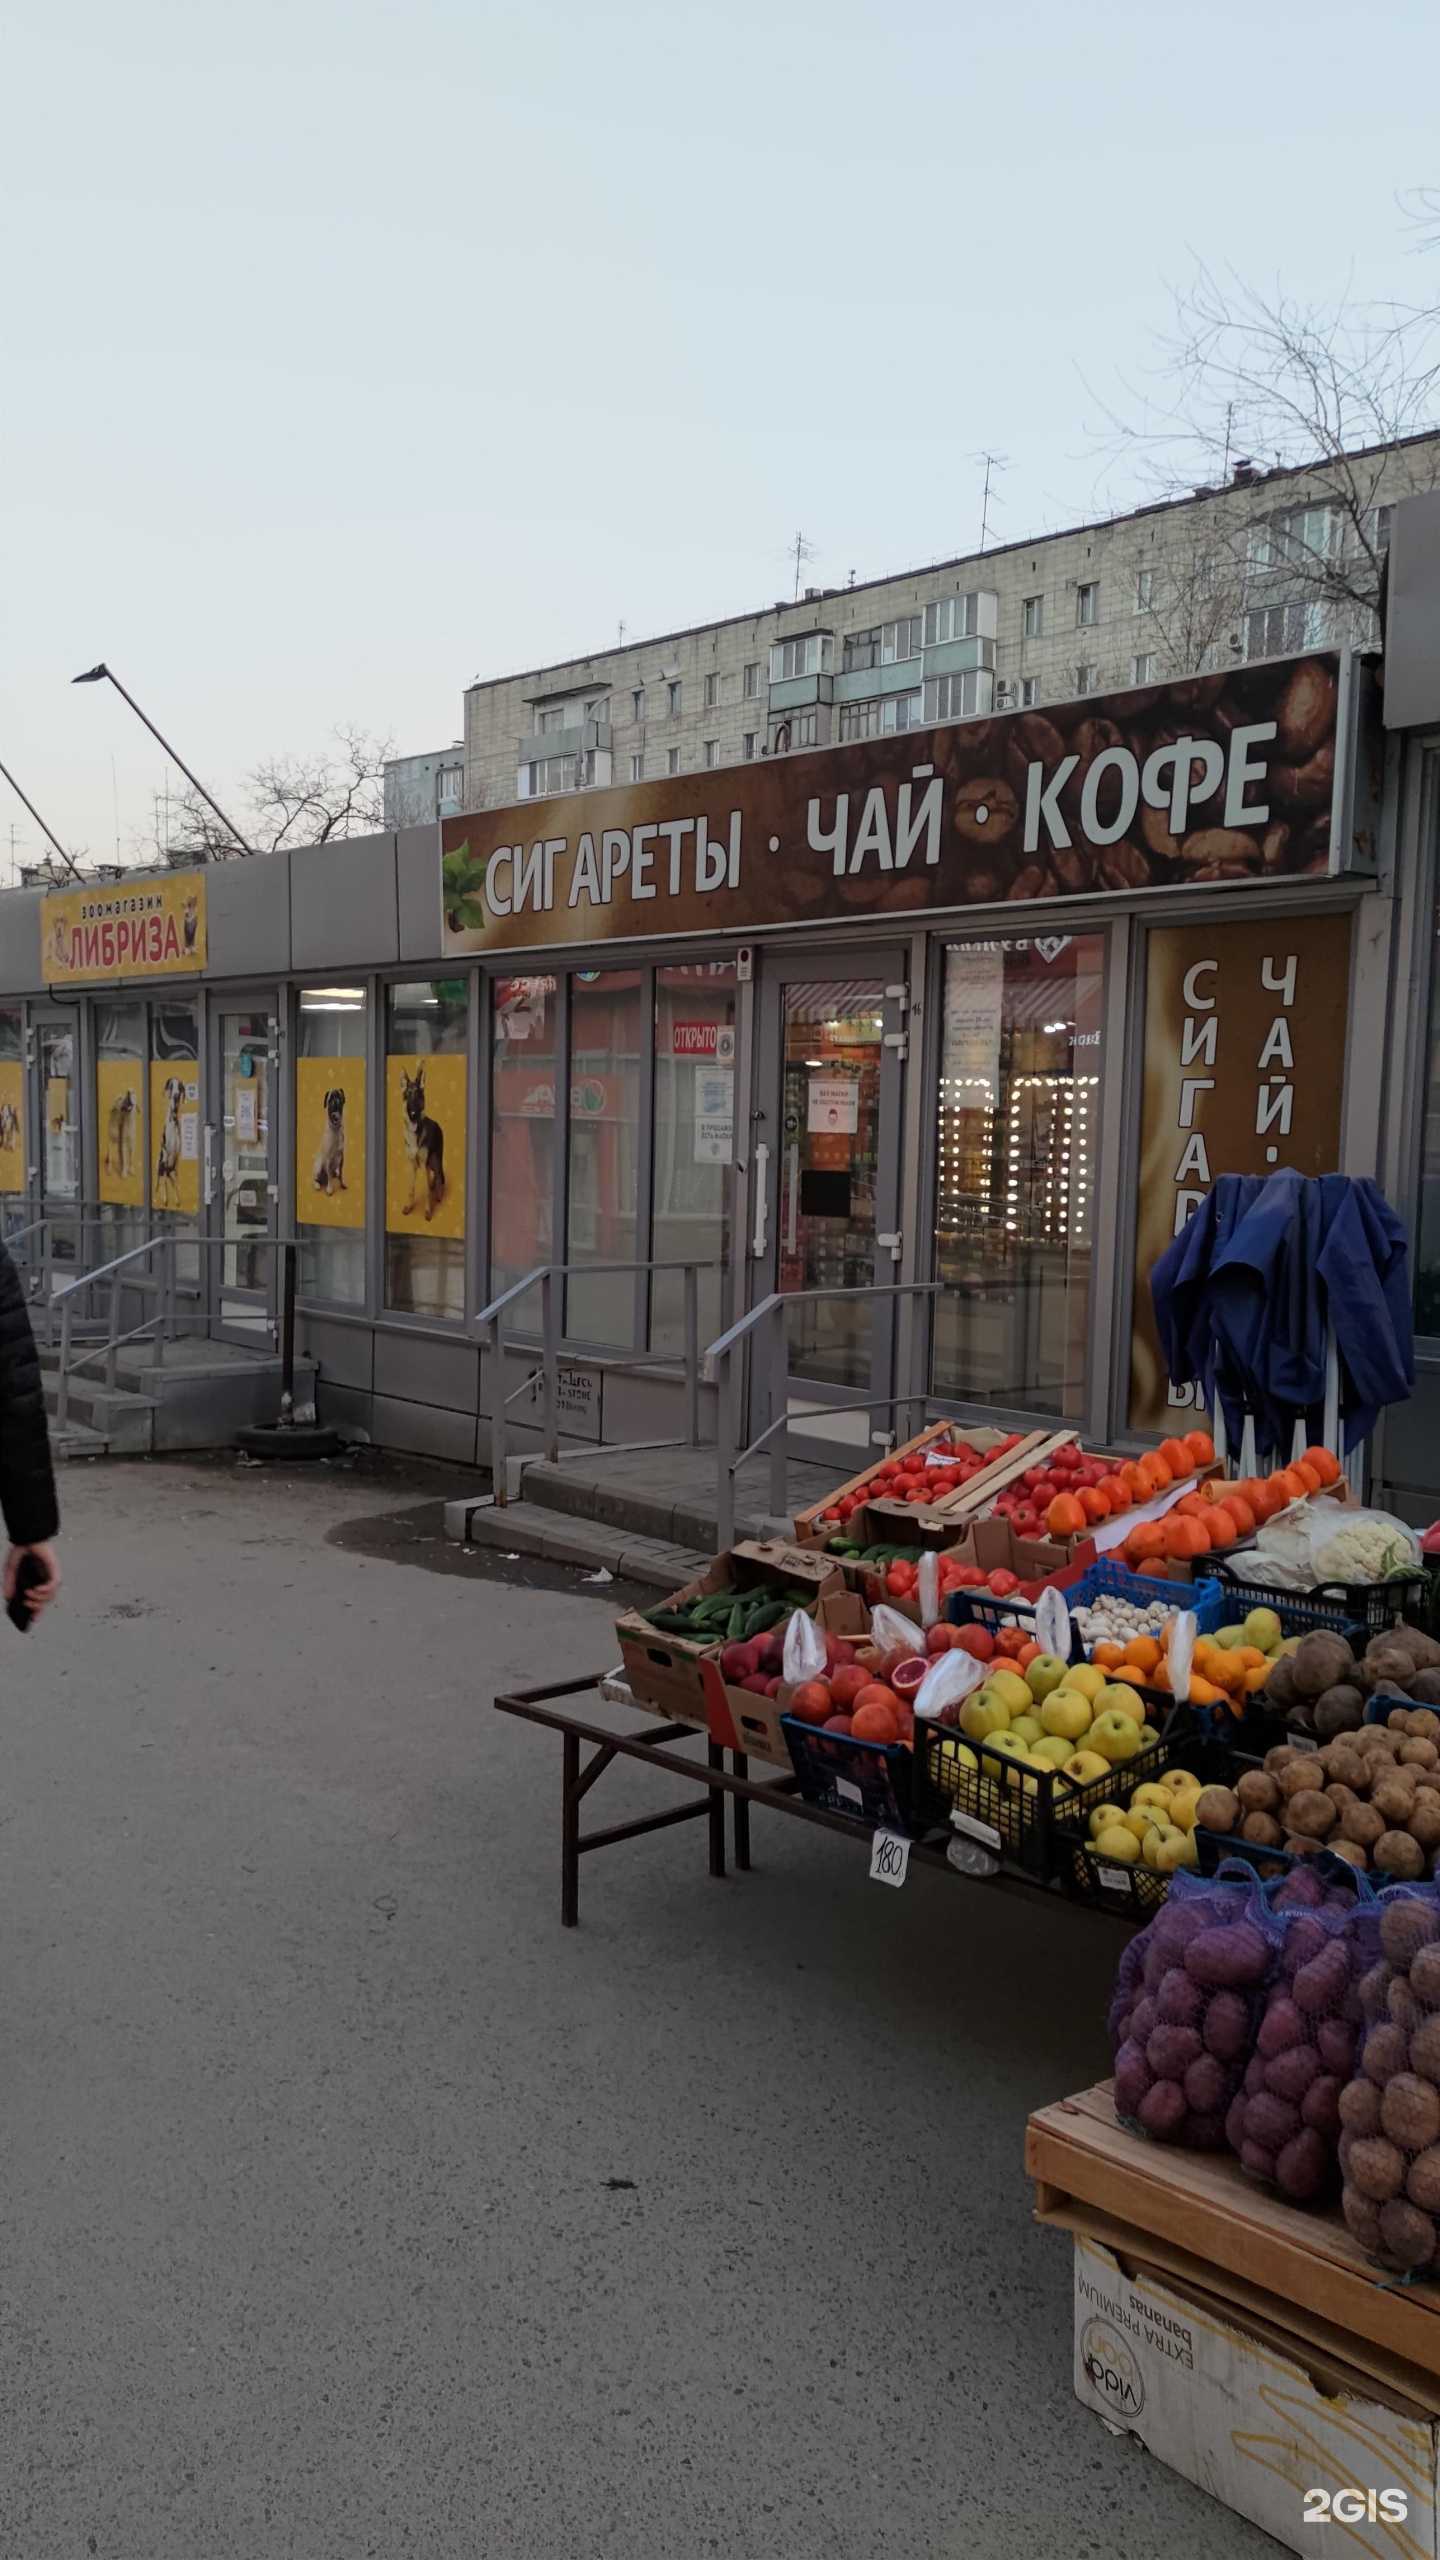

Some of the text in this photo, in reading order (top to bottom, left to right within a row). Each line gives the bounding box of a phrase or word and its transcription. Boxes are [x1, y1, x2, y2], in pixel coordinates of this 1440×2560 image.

[485, 720, 1277, 916] СИГАРЕТЫ ЧАЙ КОФЕ
[69, 914, 180, 970] ЛИБРИЗА
[674, 1025, 717, 1049] ОТКРЫТО
[1256, 955, 1298, 1135] ЧАЙ
[875, 1835, 903, 1876] 180
[1078, 2274, 1194, 2370] EXTRA PREMIUM
[1128, 2294, 1192, 2350] bananas
